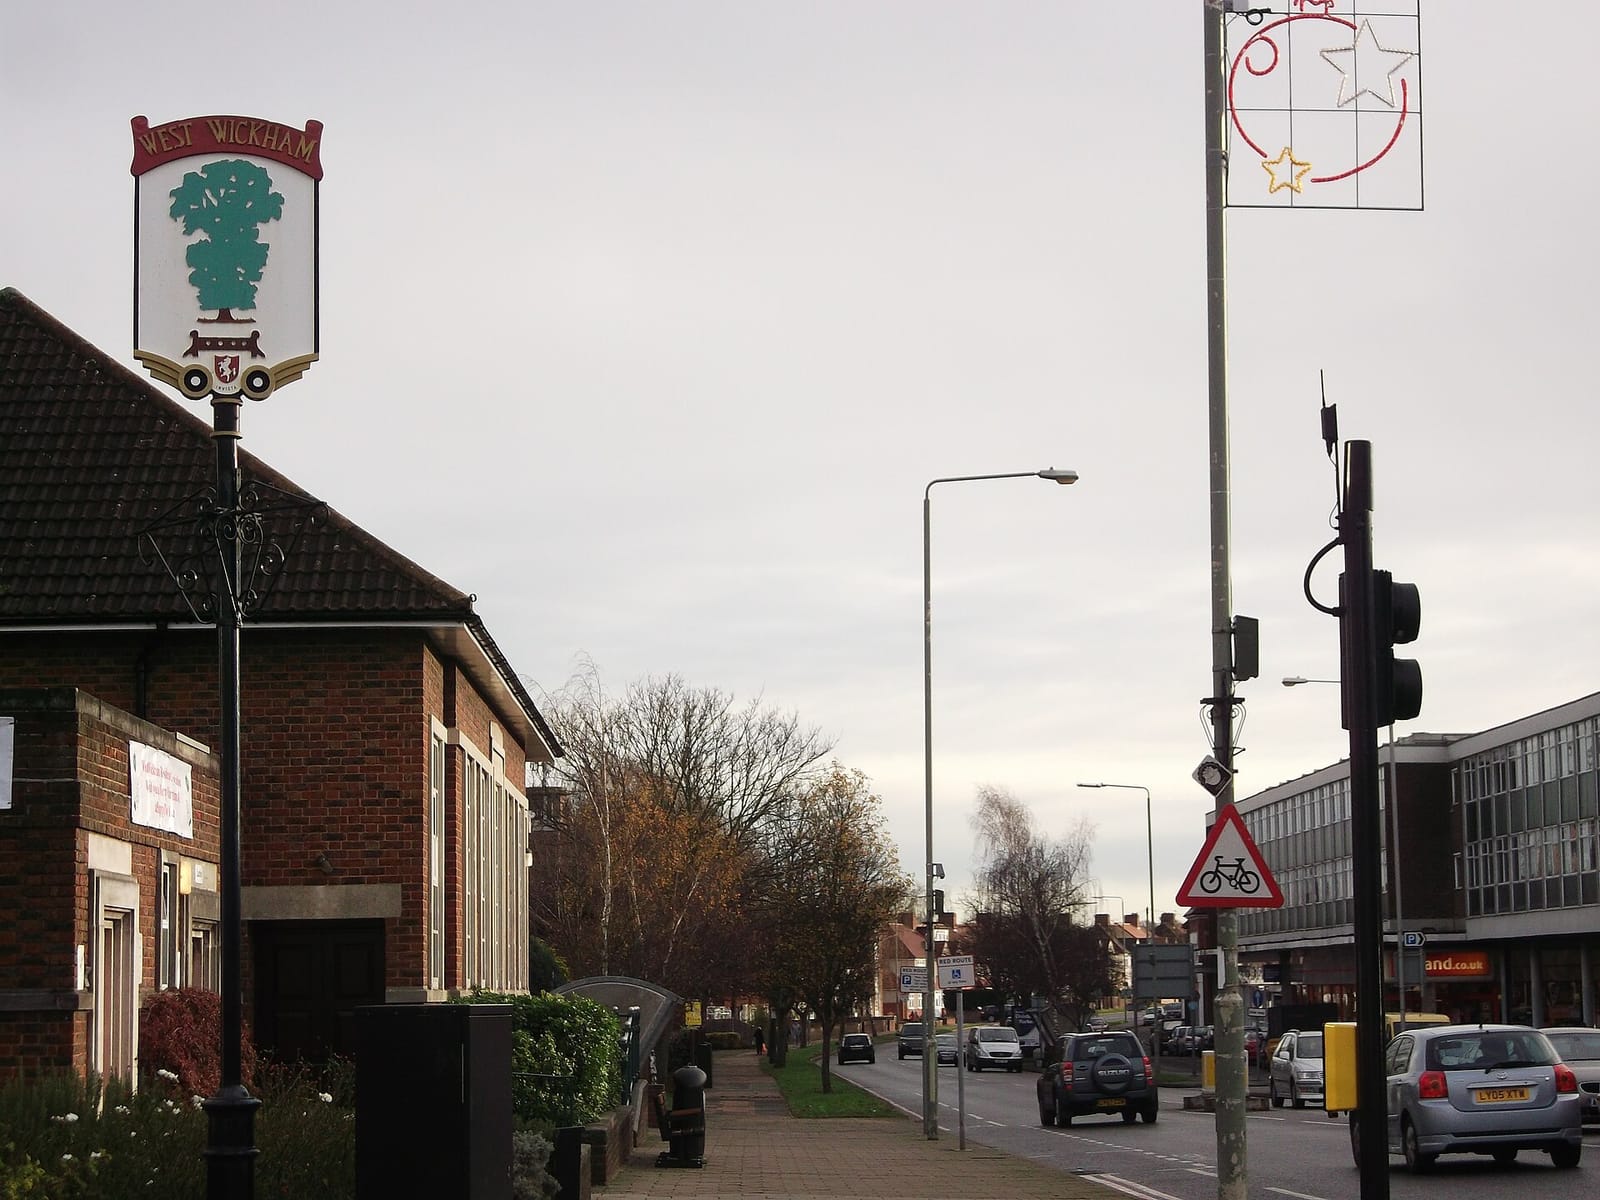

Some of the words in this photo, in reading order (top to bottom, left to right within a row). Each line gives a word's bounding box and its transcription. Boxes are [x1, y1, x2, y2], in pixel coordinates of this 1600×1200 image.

[139, 122, 193, 155] WEST
[207, 119, 318, 164] WICKHAM
[1424, 957, 1484, 971] and.co.uk
[1479, 1090, 1505, 1101] LY05
